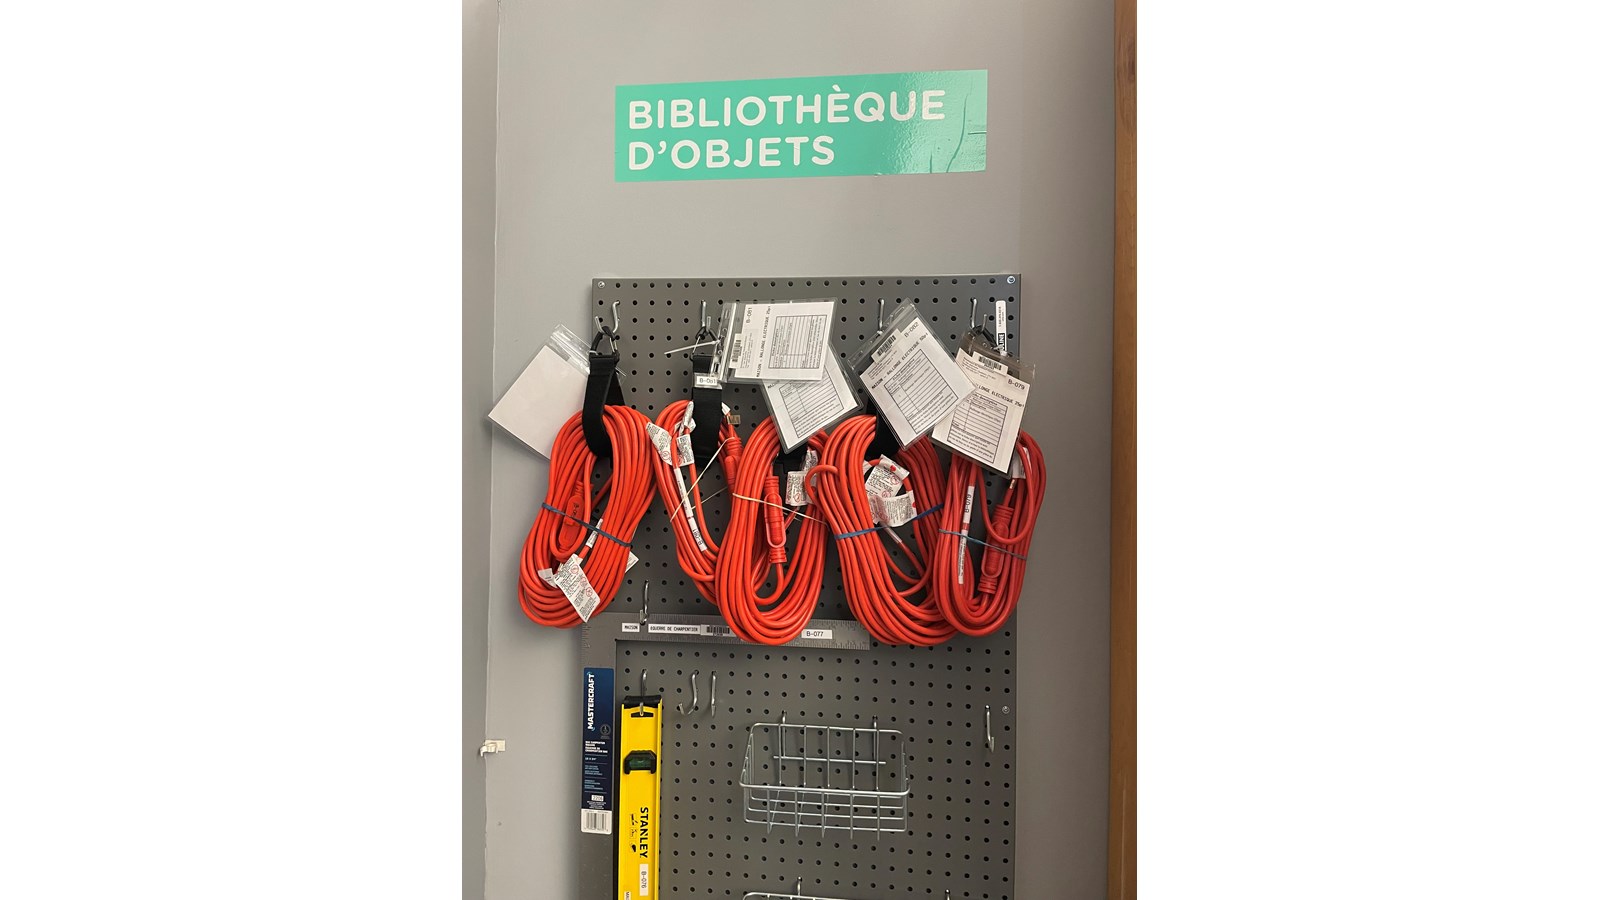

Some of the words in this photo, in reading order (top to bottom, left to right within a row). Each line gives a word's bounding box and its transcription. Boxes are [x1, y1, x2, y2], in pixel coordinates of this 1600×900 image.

[628, 84, 946, 130] BIBLIOTHÈQUE
[628, 135, 835, 171] D’OBJETS
[1007, 379, 1025, 390] B-079
[587, 673, 595, 730] MASTERCRAFT
[640, 807, 649, 858] STANLEY
